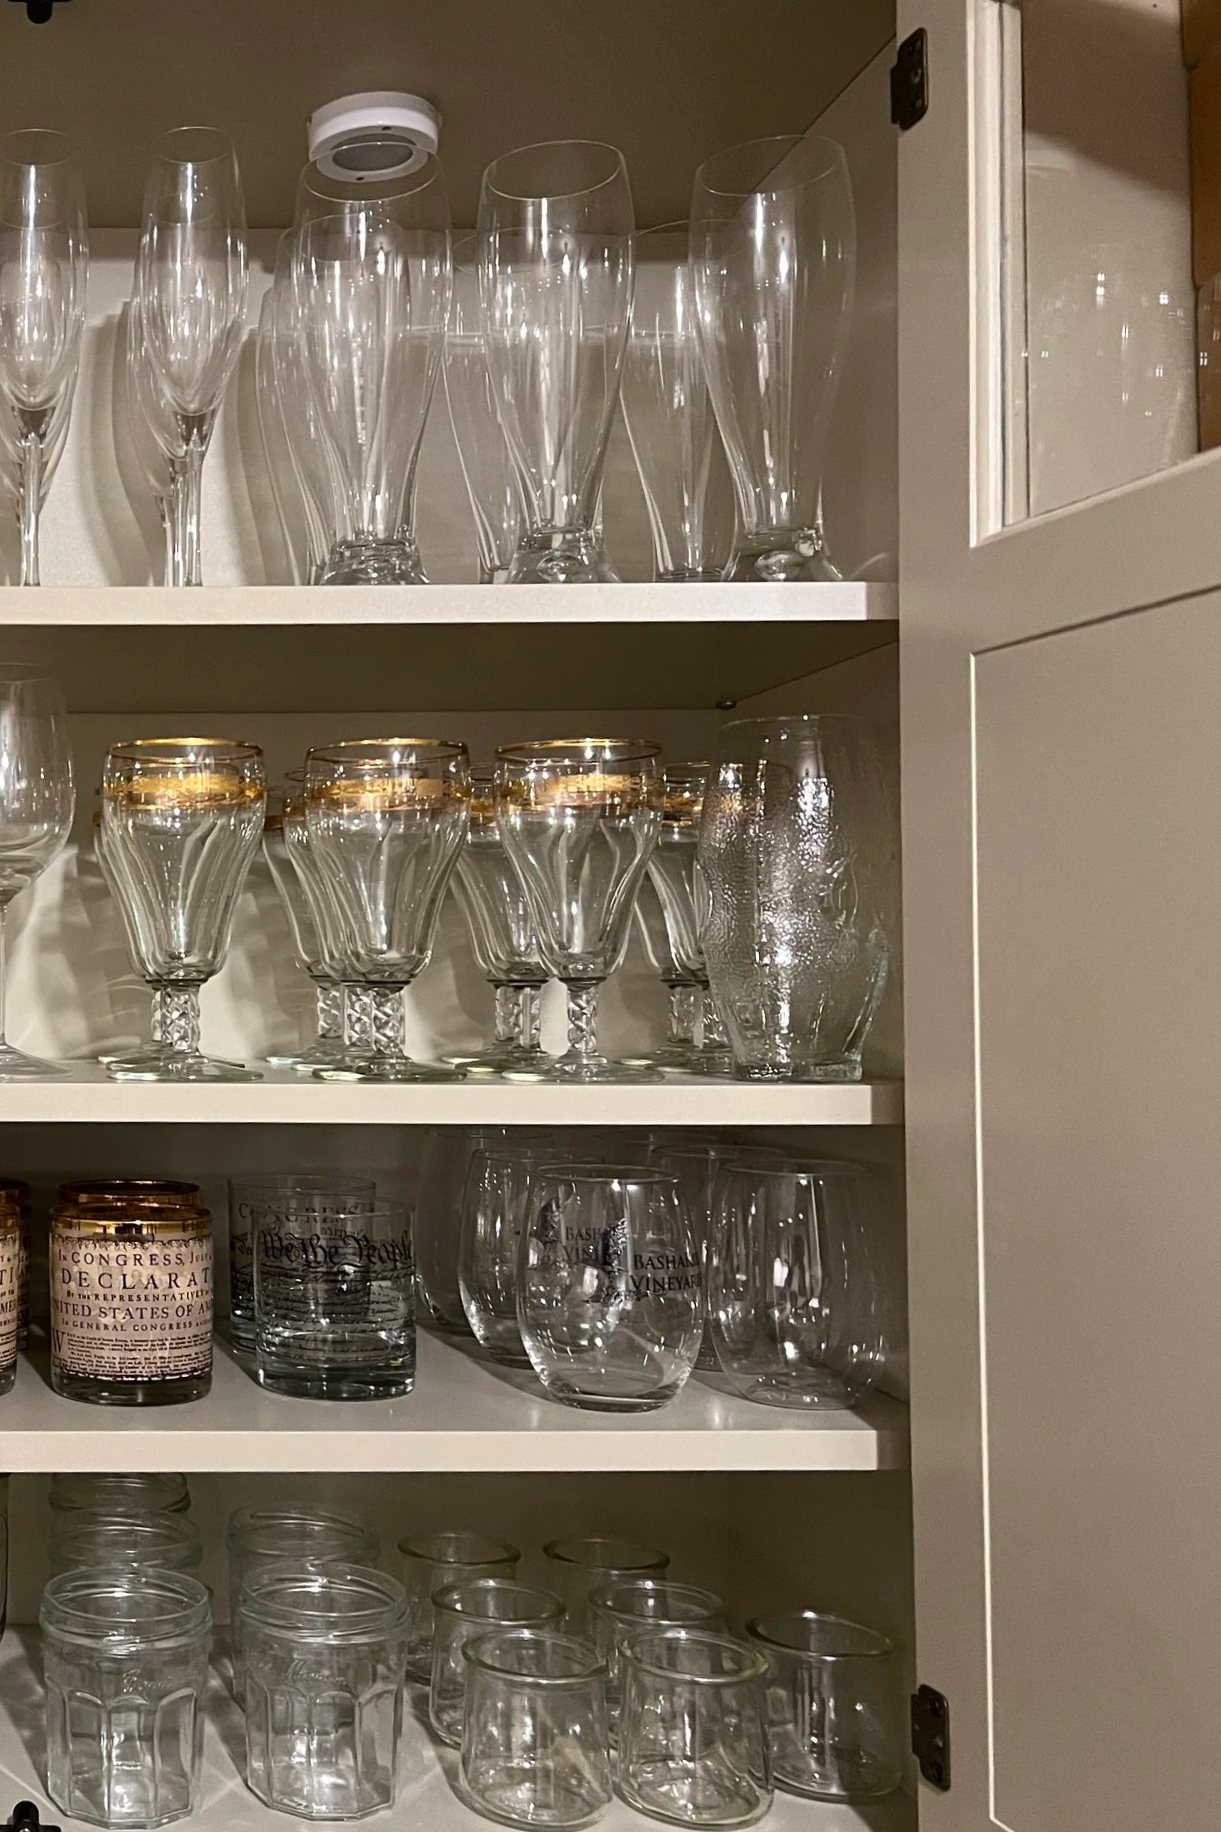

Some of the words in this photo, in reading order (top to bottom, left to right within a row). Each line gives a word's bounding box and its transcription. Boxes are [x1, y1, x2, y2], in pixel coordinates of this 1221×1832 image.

[71, 1251, 185, 1266] CONGRESS,
[94, 1289, 204, 1302] REPRESENTATIVES
[99, 1306, 169, 1320] STATES
[175, 1304, 194, 1318] OF
[72, 1320, 127, 1332] GENERAL
[133, 1321, 192, 1332] CONGRESS
